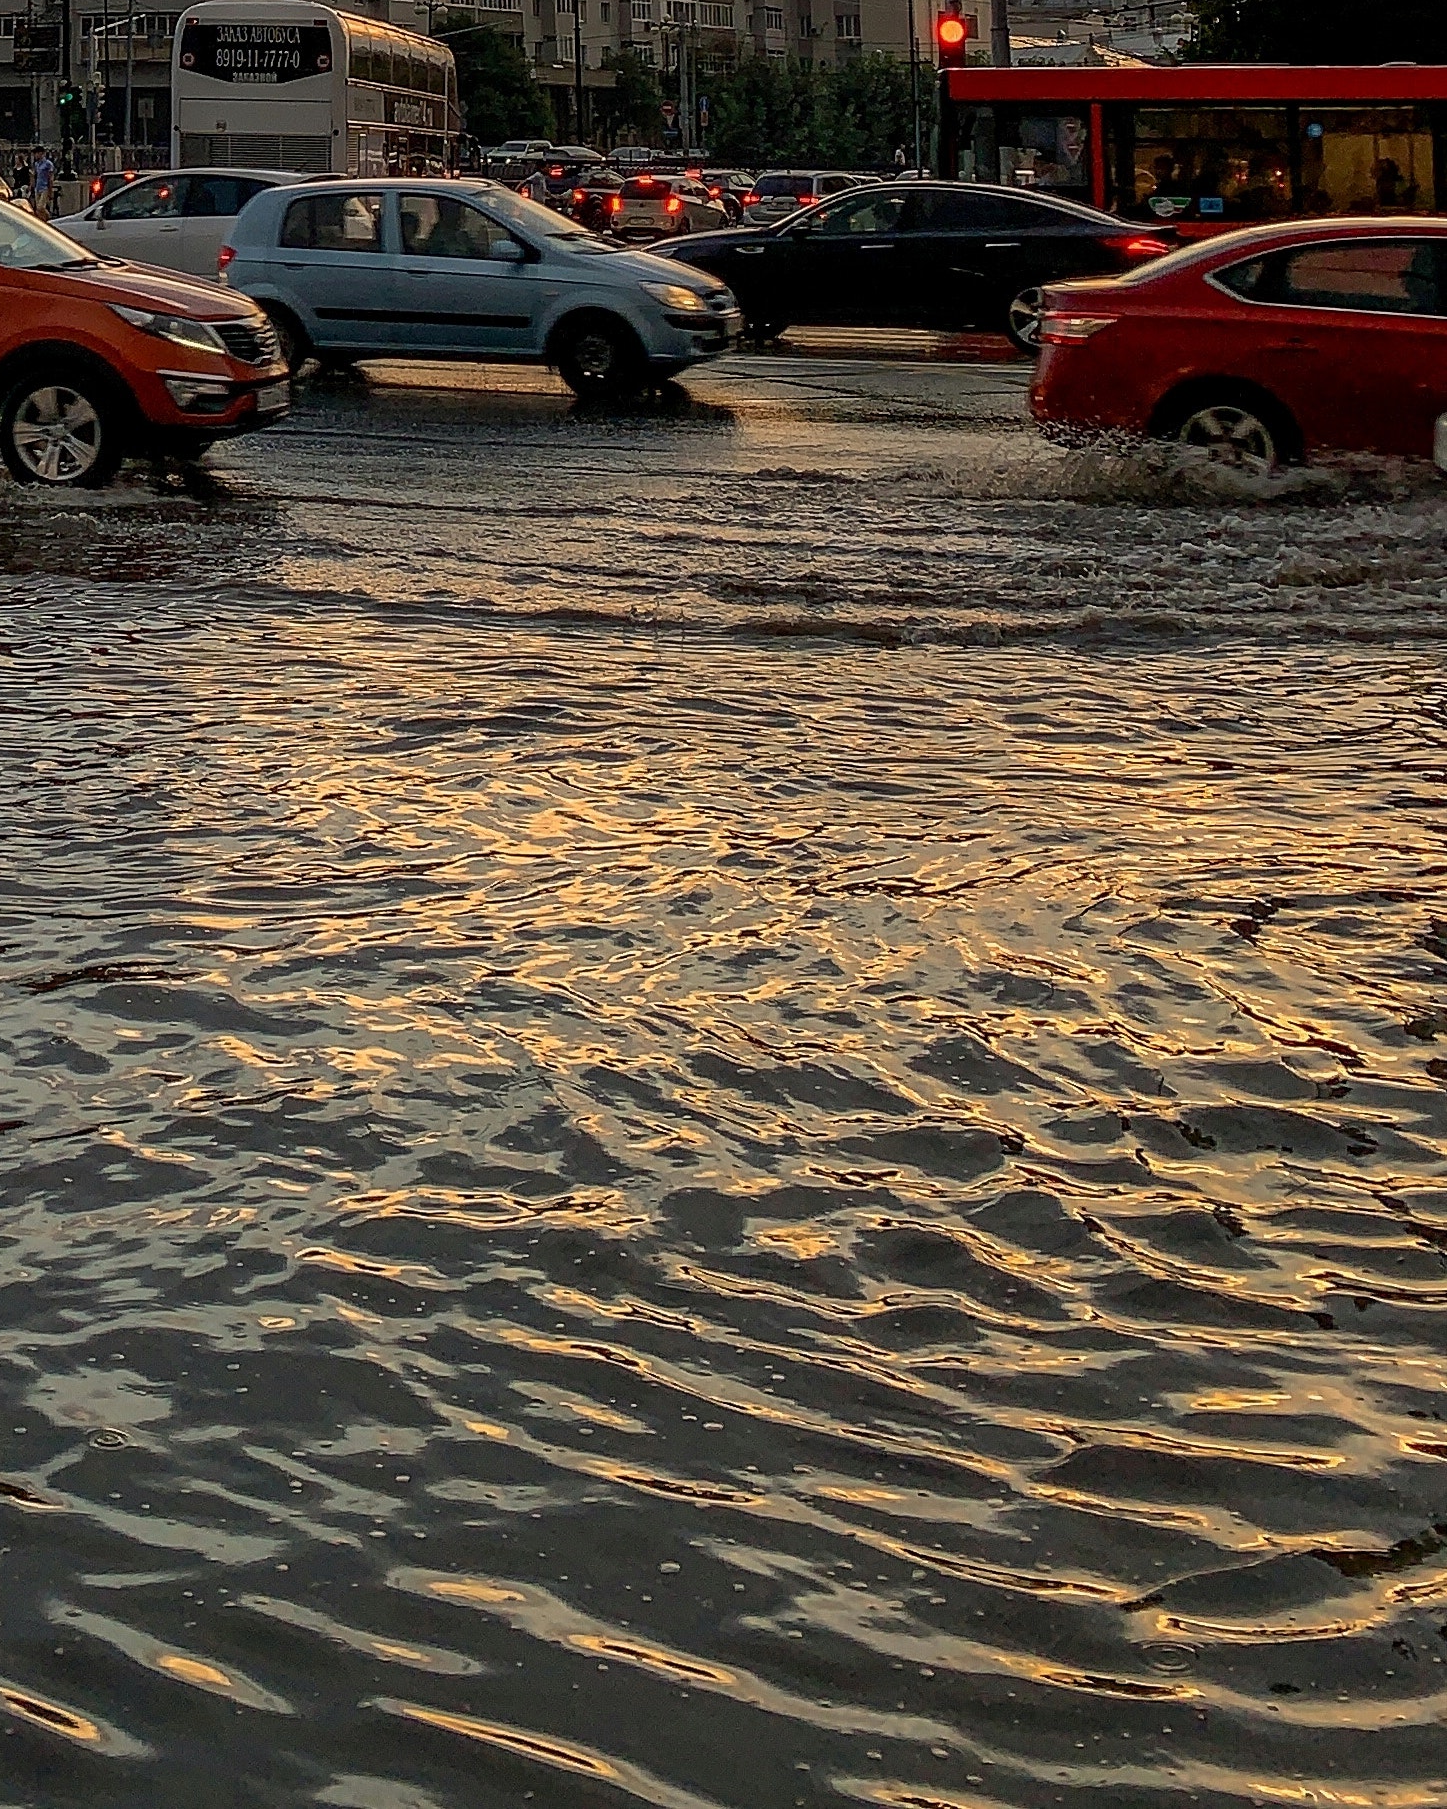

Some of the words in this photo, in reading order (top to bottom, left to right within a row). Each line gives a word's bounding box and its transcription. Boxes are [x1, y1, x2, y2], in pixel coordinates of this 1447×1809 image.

[216, 26, 248, 43] ЗАКАЗ
[249, 26, 301, 44] АВТОБУСА
[216, 48, 300, 68] 8919-11-7777-0
[232, 71, 278, 83] ЗАКАЗНОЙ
